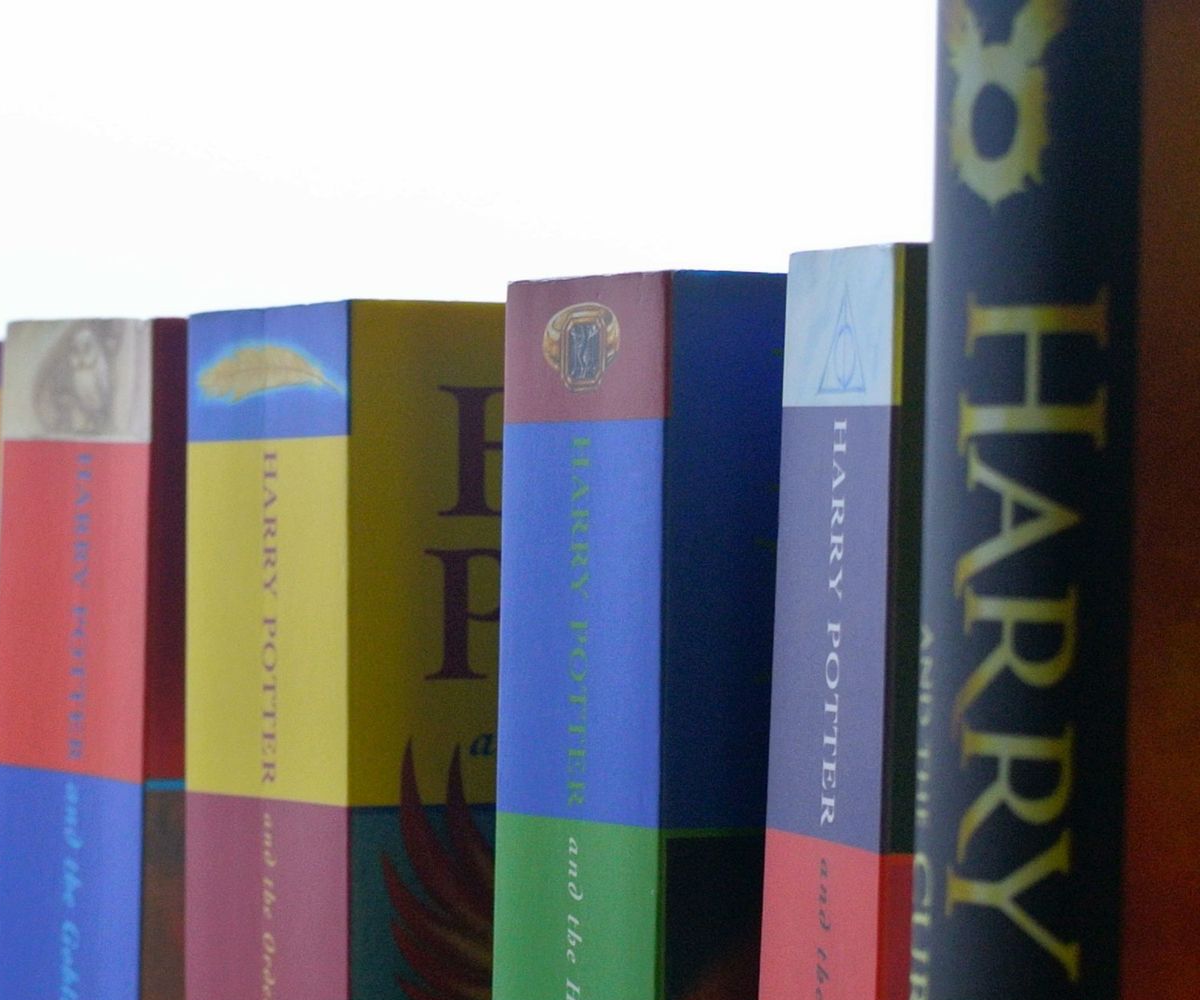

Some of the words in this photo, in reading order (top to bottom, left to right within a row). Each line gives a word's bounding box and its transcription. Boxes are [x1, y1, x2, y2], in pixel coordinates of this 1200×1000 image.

[262, 449, 279, 597] HARRY
[568, 436, 592, 599] HARRY
[828, 418, 847, 599] HARRY
[260, 614, 278, 786] POTTER
[566, 619, 589, 808] POTTER
[945, 283, 1110, 982] HARRY
[819, 621, 842, 828] POTTER
[566, 914, 583, 965] the
[567, 836, 584, 902] and
[817, 857, 834, 933] and
